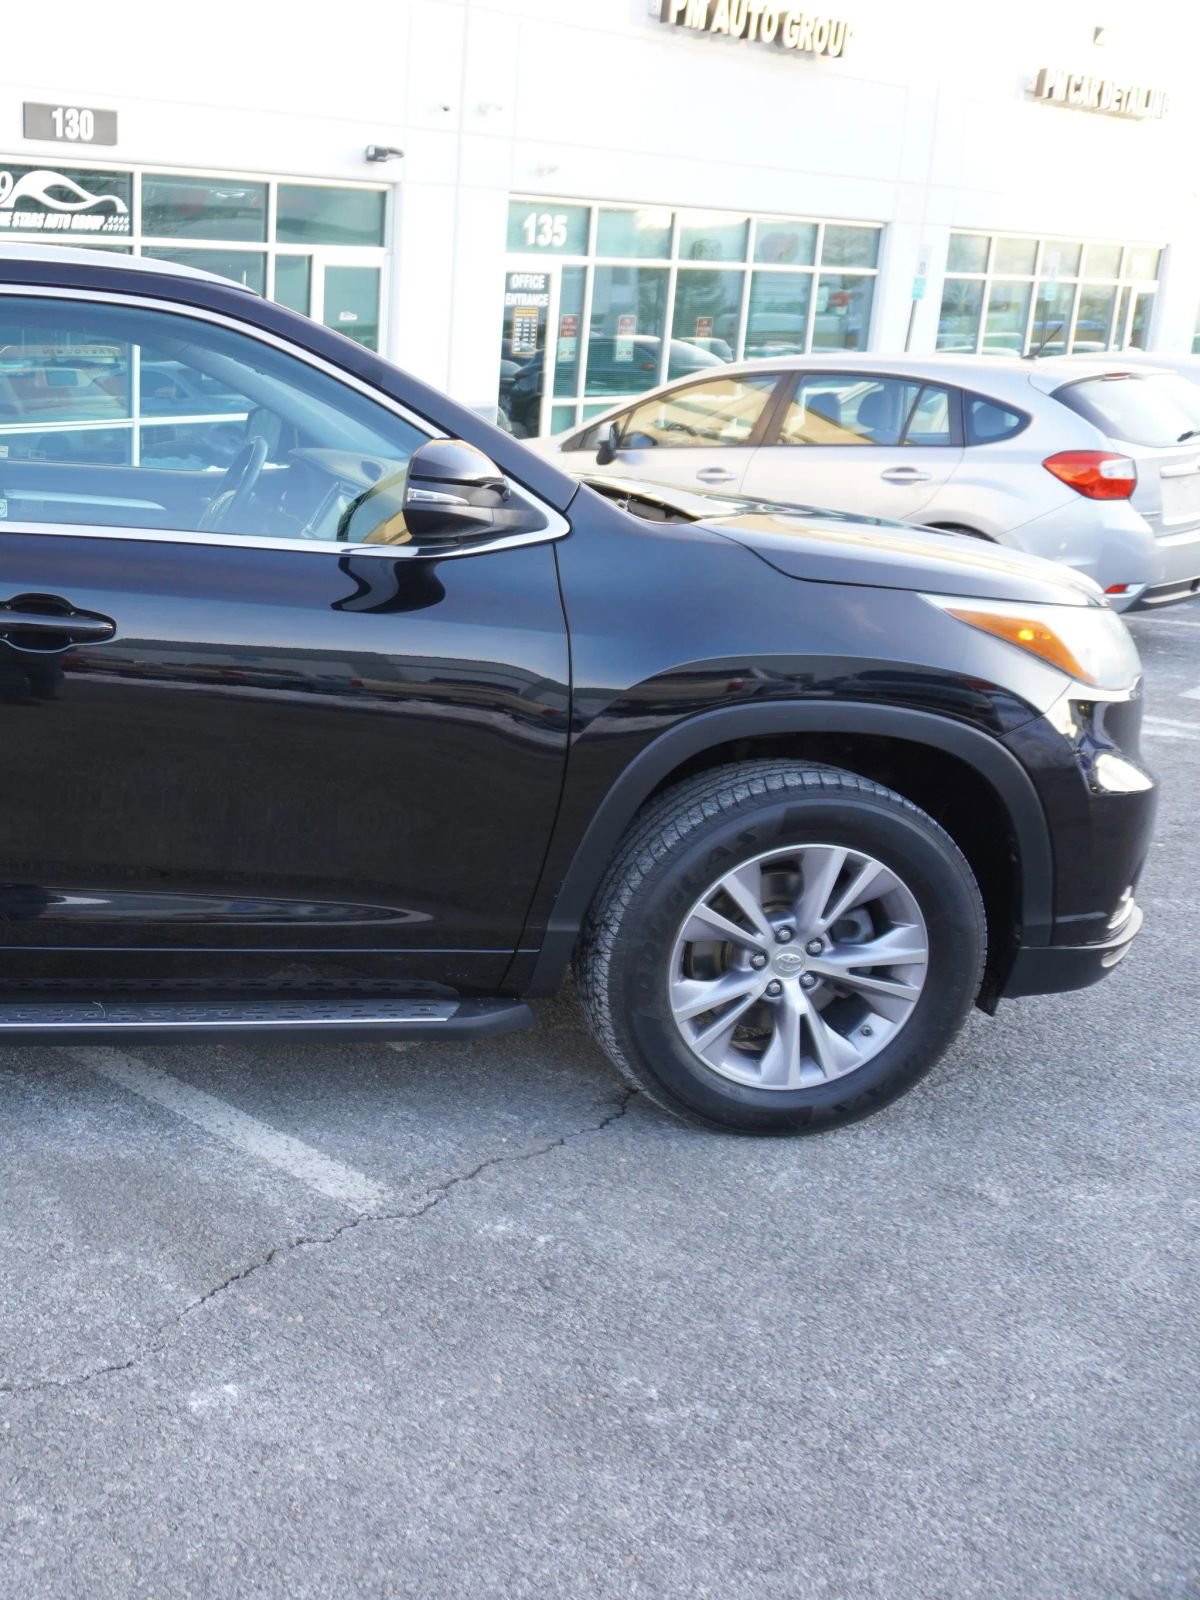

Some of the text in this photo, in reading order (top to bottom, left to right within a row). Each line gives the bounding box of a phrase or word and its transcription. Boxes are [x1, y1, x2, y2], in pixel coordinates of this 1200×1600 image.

[711, 0, 778, 43] AUTO
[51, 107, 95, 140] 130
[523, 213, 568, 247] 135
[511, 274, 545, 290] OFFICE
[505, 292, 549, 306] ENTRANCE
